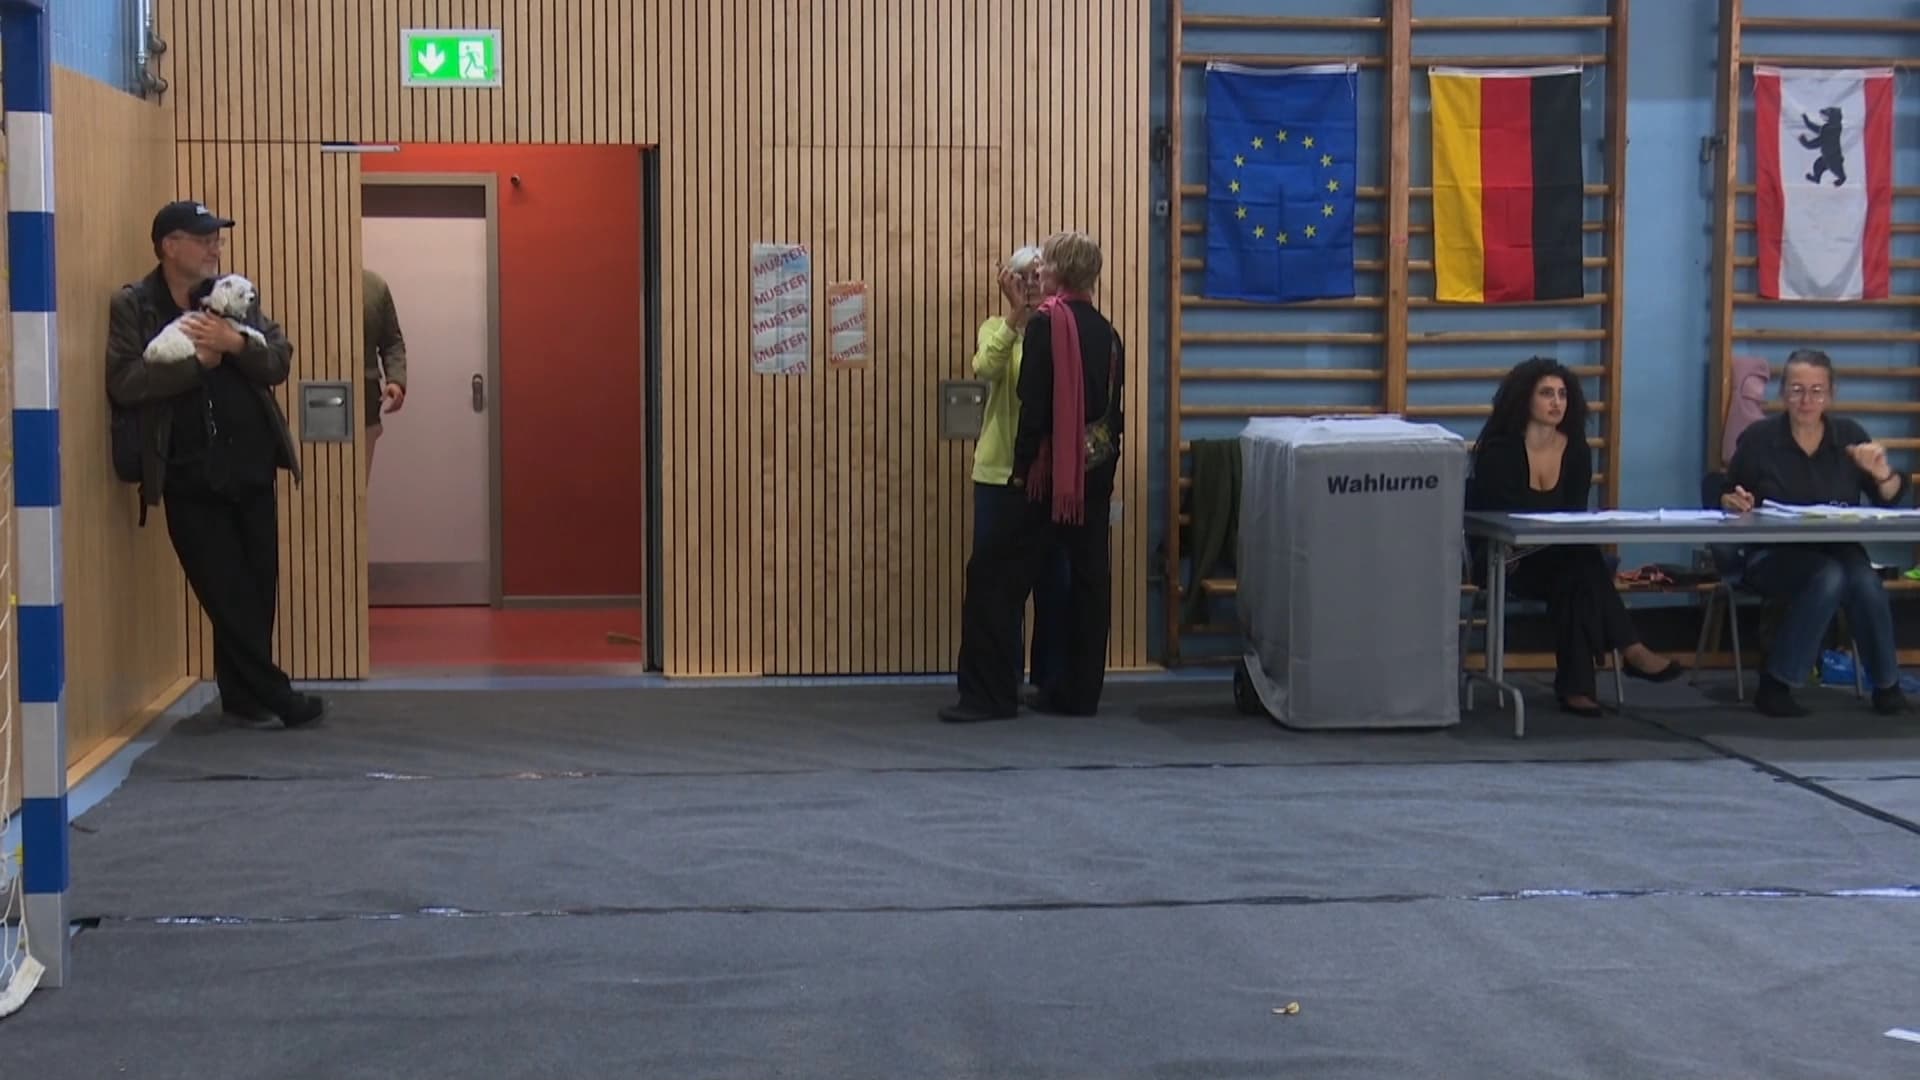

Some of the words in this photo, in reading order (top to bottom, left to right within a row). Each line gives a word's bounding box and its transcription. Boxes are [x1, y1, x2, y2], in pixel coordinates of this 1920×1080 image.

[754, 246, 807, 277] MUSTER
[754, 274, 807, 305] MUSTER
[753, 304, 807, 335] MUSTER
[753, 332, 807, 364] MUSTER
[1328, 473, 1439, 494] Wahlurne
